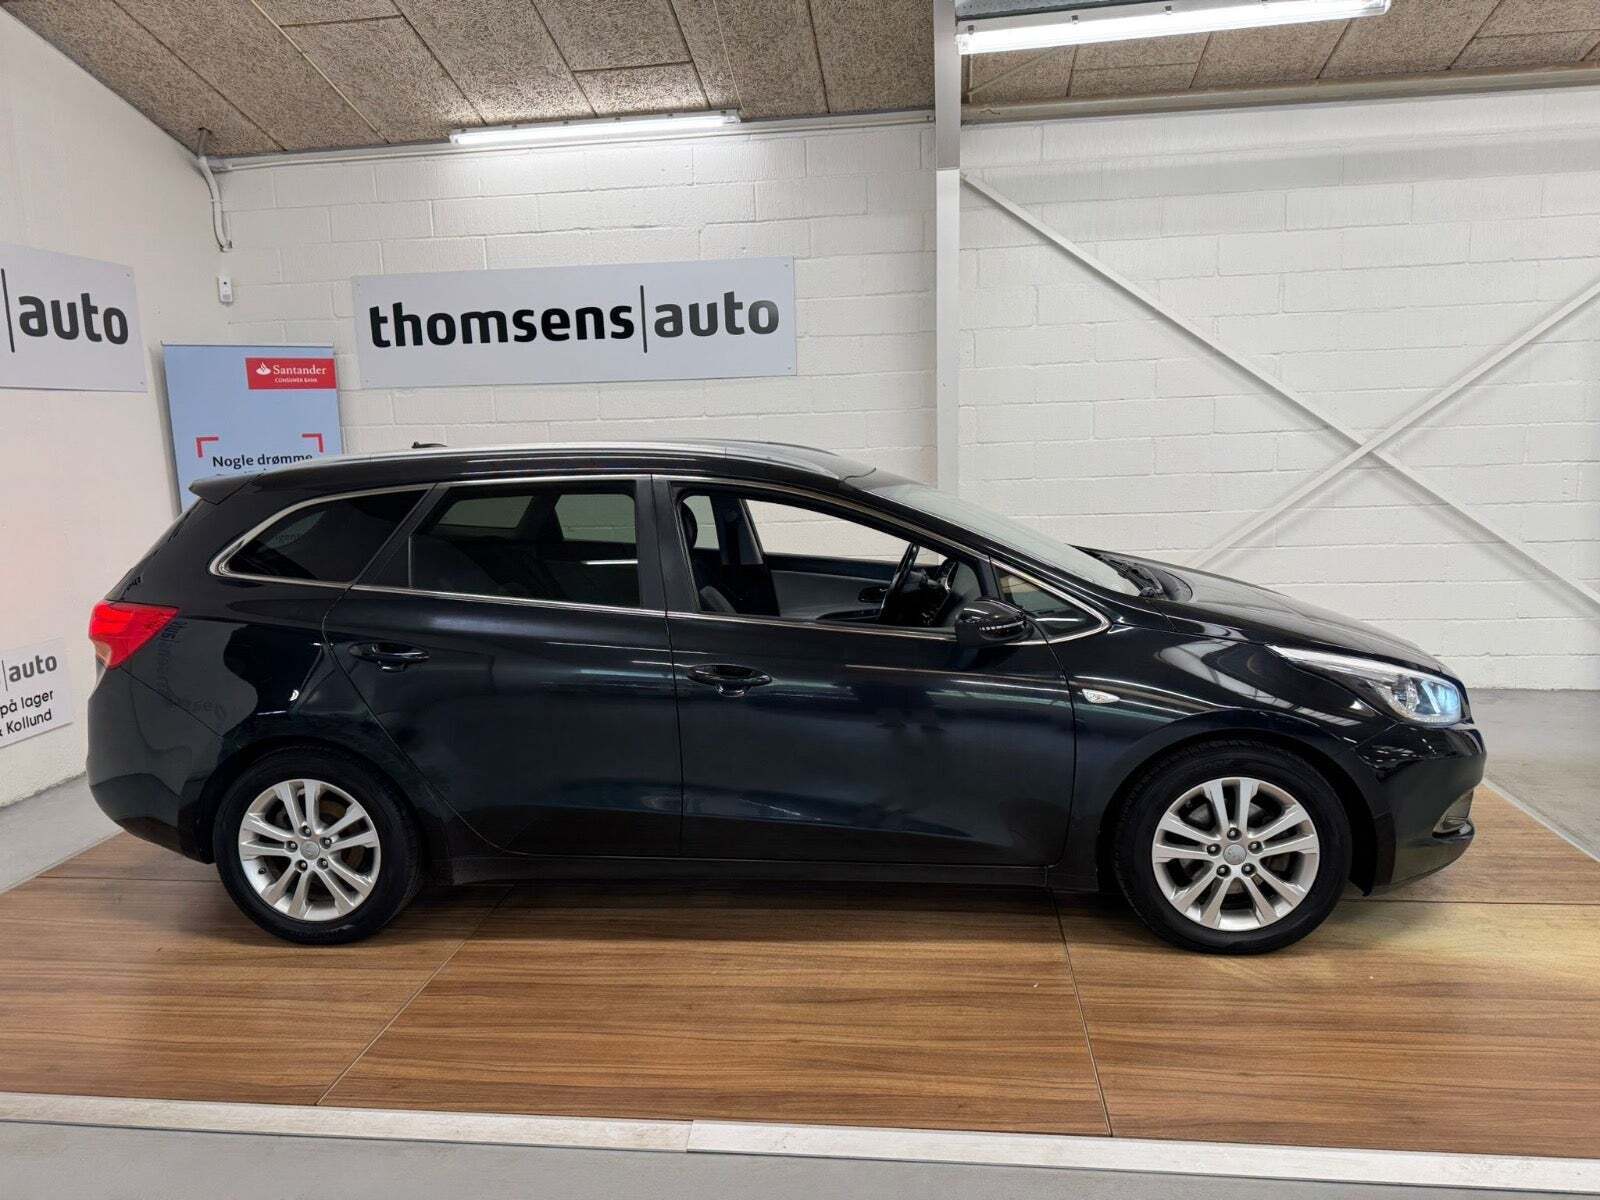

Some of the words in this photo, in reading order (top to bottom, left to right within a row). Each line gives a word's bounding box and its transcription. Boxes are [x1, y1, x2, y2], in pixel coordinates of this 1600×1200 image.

[369, 301, 634, 348] thomsens
[273, 364, 326, 375] Santander
[212, 454, 254, 469] Nogle
[0, 699, 18, 718] på
[21, 690, 53, 709] lager
[6, 708, 52, 734] Kollund
